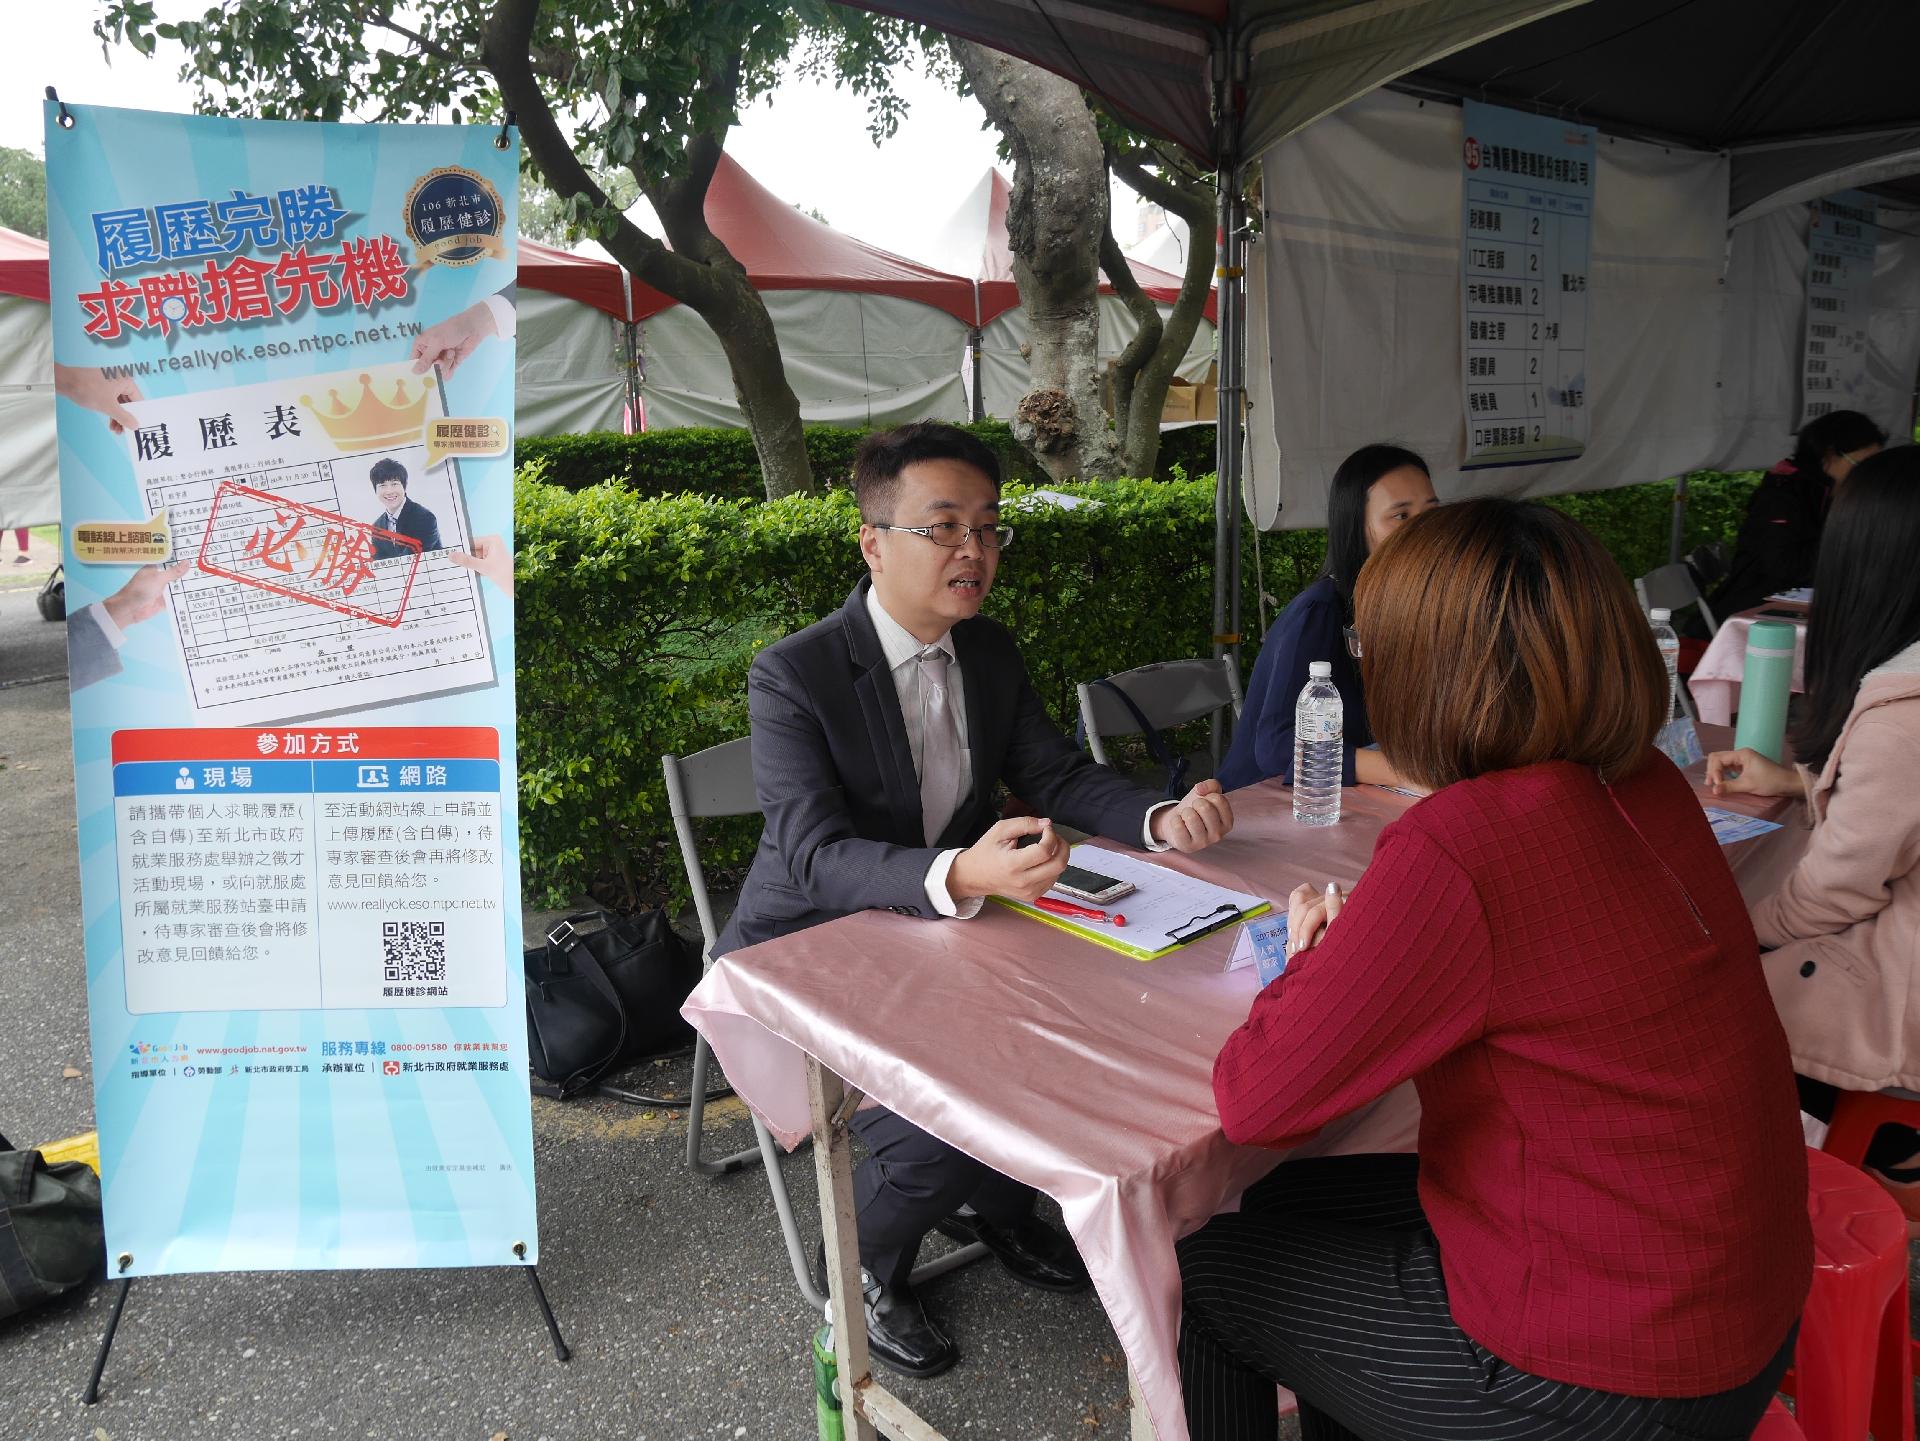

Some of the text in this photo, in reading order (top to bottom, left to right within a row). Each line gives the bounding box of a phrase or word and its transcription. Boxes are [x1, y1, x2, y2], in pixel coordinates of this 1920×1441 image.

[1465, 140, 1479, 163] 95
[422, 194, 480, 212] 106 新北市
[420, 209, 492, 234] 履歷健診
[1532, 216, 1540, 235] 2
[91, 185, 351, 276] 履歷完勝
[1530, 254, 1538, 271] 2
[77, 234, 411, 340] 求職搶先機
[1532, 288, 1538, 305] 2
[1531, 323, 1538, 340] 2
[101, 321, 422, 381] www.reallyok.eso.ntpc.net.tw
[1530, 357, 1537, 374] 2
[1532, 391, 1538, 408] 1
[134, 405, 301, 463] 履歷表
[436, 424, 489, 438] 履歷健診
[1534, 425, 1541, 442] 2
[77, 530, 151, 543] 電話線上諮詢
[241, 508, 376, 597] 必勝
[256, 732, 359, 755] 參加方式
[203, 765, 447, 788] 現場 網路
[324, 801, 492, 819] 至活動網站線上申請並
[132, 850, 304, 869] 就業服務處舉辦之徵才
[326, 848, 494, 866] 專家審查後會再將修改
[327, 897, 496, 914] www.reallyok.eso.ntpc.net.tw
[382, 985, 448, 998] 履歷健診網站
[196, 1044, 307, 1056] www.goodjob.nat.gov.tw
[321, 1041, 387, 1056] 服務專線
[391, 1043, 448, 1052] 0800-091580
[131, 1065, 309, 1079] 指導單位 勞動部 新北市政府勞工局
[322, 1061, 510, 1073] 承辦單位 新北市政府就業服務處
